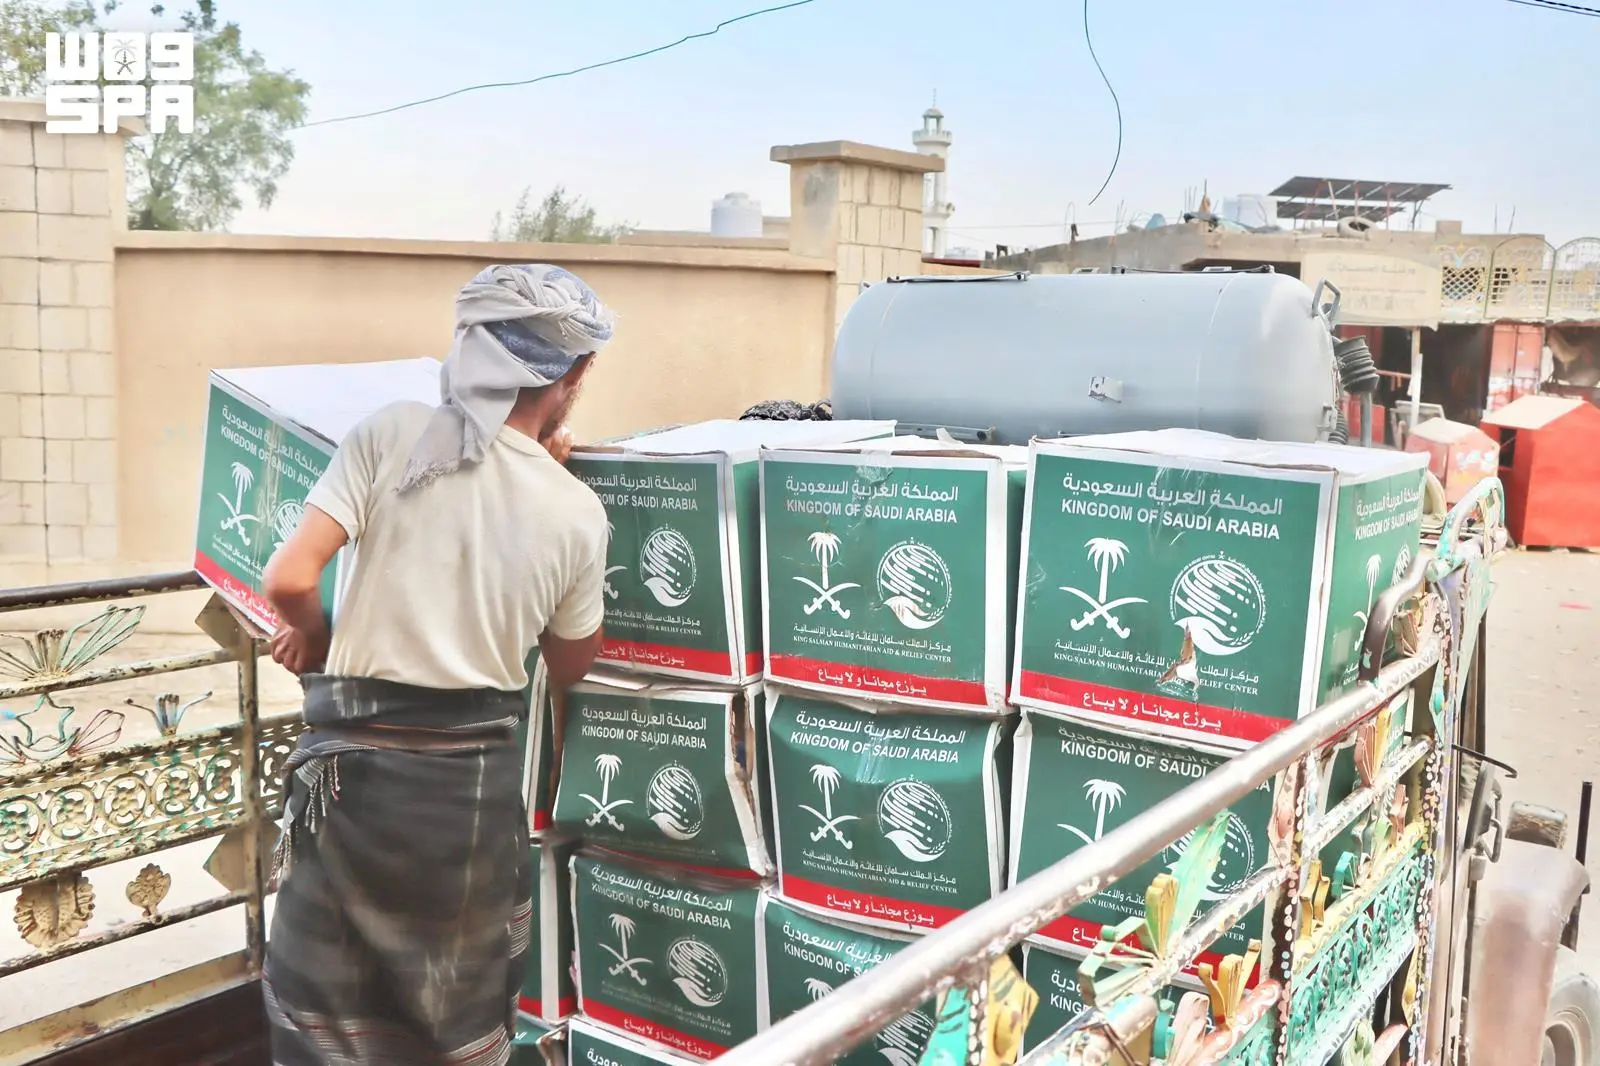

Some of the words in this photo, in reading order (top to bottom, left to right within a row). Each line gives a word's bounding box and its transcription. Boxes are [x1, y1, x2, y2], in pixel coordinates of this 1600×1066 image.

[222, 404, 263, 440] السعودية
[221, 424, 257, 456] KINGDOM
[258, 448, 269, 461] OF
[271, 456, 296, 479] SAUDI
[297, 474, 315, 489] ARA
[620, 473, 653, 492] العربية
[655, 475, 697, 492] المملكة
[786, 476, 848, 496] السعودية
[851, 480, 898, 500] العربية
[901, 483, 958, 501] المملكة
[1063, 473, 1142, 498] السعودية
[617, 494, 629, 506] OF
[632, 496, 659, 509] SAUDI
[662, 498, 698, 511] ARABIA
[1147, 481, 1205, 506] العربية
[1210, 489, 1282, 515] المملكة
[787, 500, 841, 516] KINGDOM
[845, 503, 861, 517] OF
[865, 504, 902, 520] SAUDI
[906, 507, 957, 523] ARABIA
[1357, 498, 1385, 520] السعودية
[1062, 499, 1133, 520] KINGDOM
[1137, 508, 1158, 523] OF
[1163, 511, 1212, 531] SAUDI
[1216, 520, 1280, 539] ARABIA
[1355, 521, 1382, 540] KINGDOM
[1383, 518, 1390, 530] OF
[1391, 514, 1404, 529] SAUDI
[793, 636, 808, 644] KING
[809, 637, 833, 646] SALMAN
[834, 640, 881, 653] HUMANITARIAN
[883, 646, 894, 654] AID
[901, 650, 924, 659] RELIEF
[925, 652, 951, 663] CENTER
[880, 635, 904, 646] سلمان
[905, 638, 927, 649] الملك
[929, 642, 952, 652] مركز
[618, 646, 625, 656] لا
[818, 668, 843, 682] يباع
[844, 671, 853, 682] لا
[1054, 652, 1073, 662] KING
[1074, 654, 1105, 667] SALMAN
[1107, 660, 1165, 678] HUMANITARIA
[1200, 678, 1223, 689] ELIEF
[1225, 681, 1258, 695] CENTER
[1201, 664, 1228, 678] الملك
[1231, 672, 1259, 684] مركز
[857, 676, 861, 686] و
[897, 679, 927, 695] يوزع
[1083, 692, 1116, 709] يباع
[1120, 698, 1128, 711] لا
[1133, 704, 1139, 716] و
[582, 705, 628, 722] السعودية
[631, 708, 665, 728] العربية
[667, 712, 706, 730] المملكة
[797, 711, 862, 734] السعودية
[1183, 709, 1222, 731] يوزع
[582, 725, 624, 740] KINGDOM
[626, 729, 638, 741] OF
[641, 731, 669, 744] SAUDI
[672, 736, 706, 749] ARABIA
[864, 721, 910, 740] العربية
[912, 726, 966, 744] المملكة
[791, 732, 849, 751] KINGDOM
[852, 741, 870, 754] OF
[873, 745, 910, 760] SAUDI
[911, 749, 959, 763] ARABIA
[1061, 740, 1130, 765] KINGDOM
[1135, 753, 1155, 769] OF
[1159, 758, 1207, 778] SAUDI
[591, 864, 642, 890] السعودية
[803, 859, 817, 868] KING
[818, 862, 840, 873] SALMAN
[840, 868, 887, 883] HUMANITARIAN
[888, 876, 899, 884] AID
[907, 881, 929, 890] RELIEF
[931, 883, 957, 894] CENTER
[884, 865, 909, 876] سلمان
[912, 870, 932, 880] الملك
[934, 874, 956, 884] مركز
[644, 882, 681, 901] العربية
[826, 893, 851, 908] يباع
[684, 891, 733, 912] المملكة
[852, 898, 861, 908] لا
[865, 904, 870, 913] و
[637, 897, 649, 910] OF
[652, 904, 685, 920] SAUDI
[688, 911, 731, 930] ARABIA
[904, 908, 934, 925] يوزع
[1100, 899, 1145, 918] HUMANITARI
[1223, 932, 1244, 941] NTER
[783, 921, 844, 952] السعودية
[1072, 927, 1102, 944] باع
[784, 942, 833, 969] KINGDOM
[836, 961, 851, 975] OF
[1050, 993, 1083, 1014] KING
[646, 1025, 653, 1036] لا
